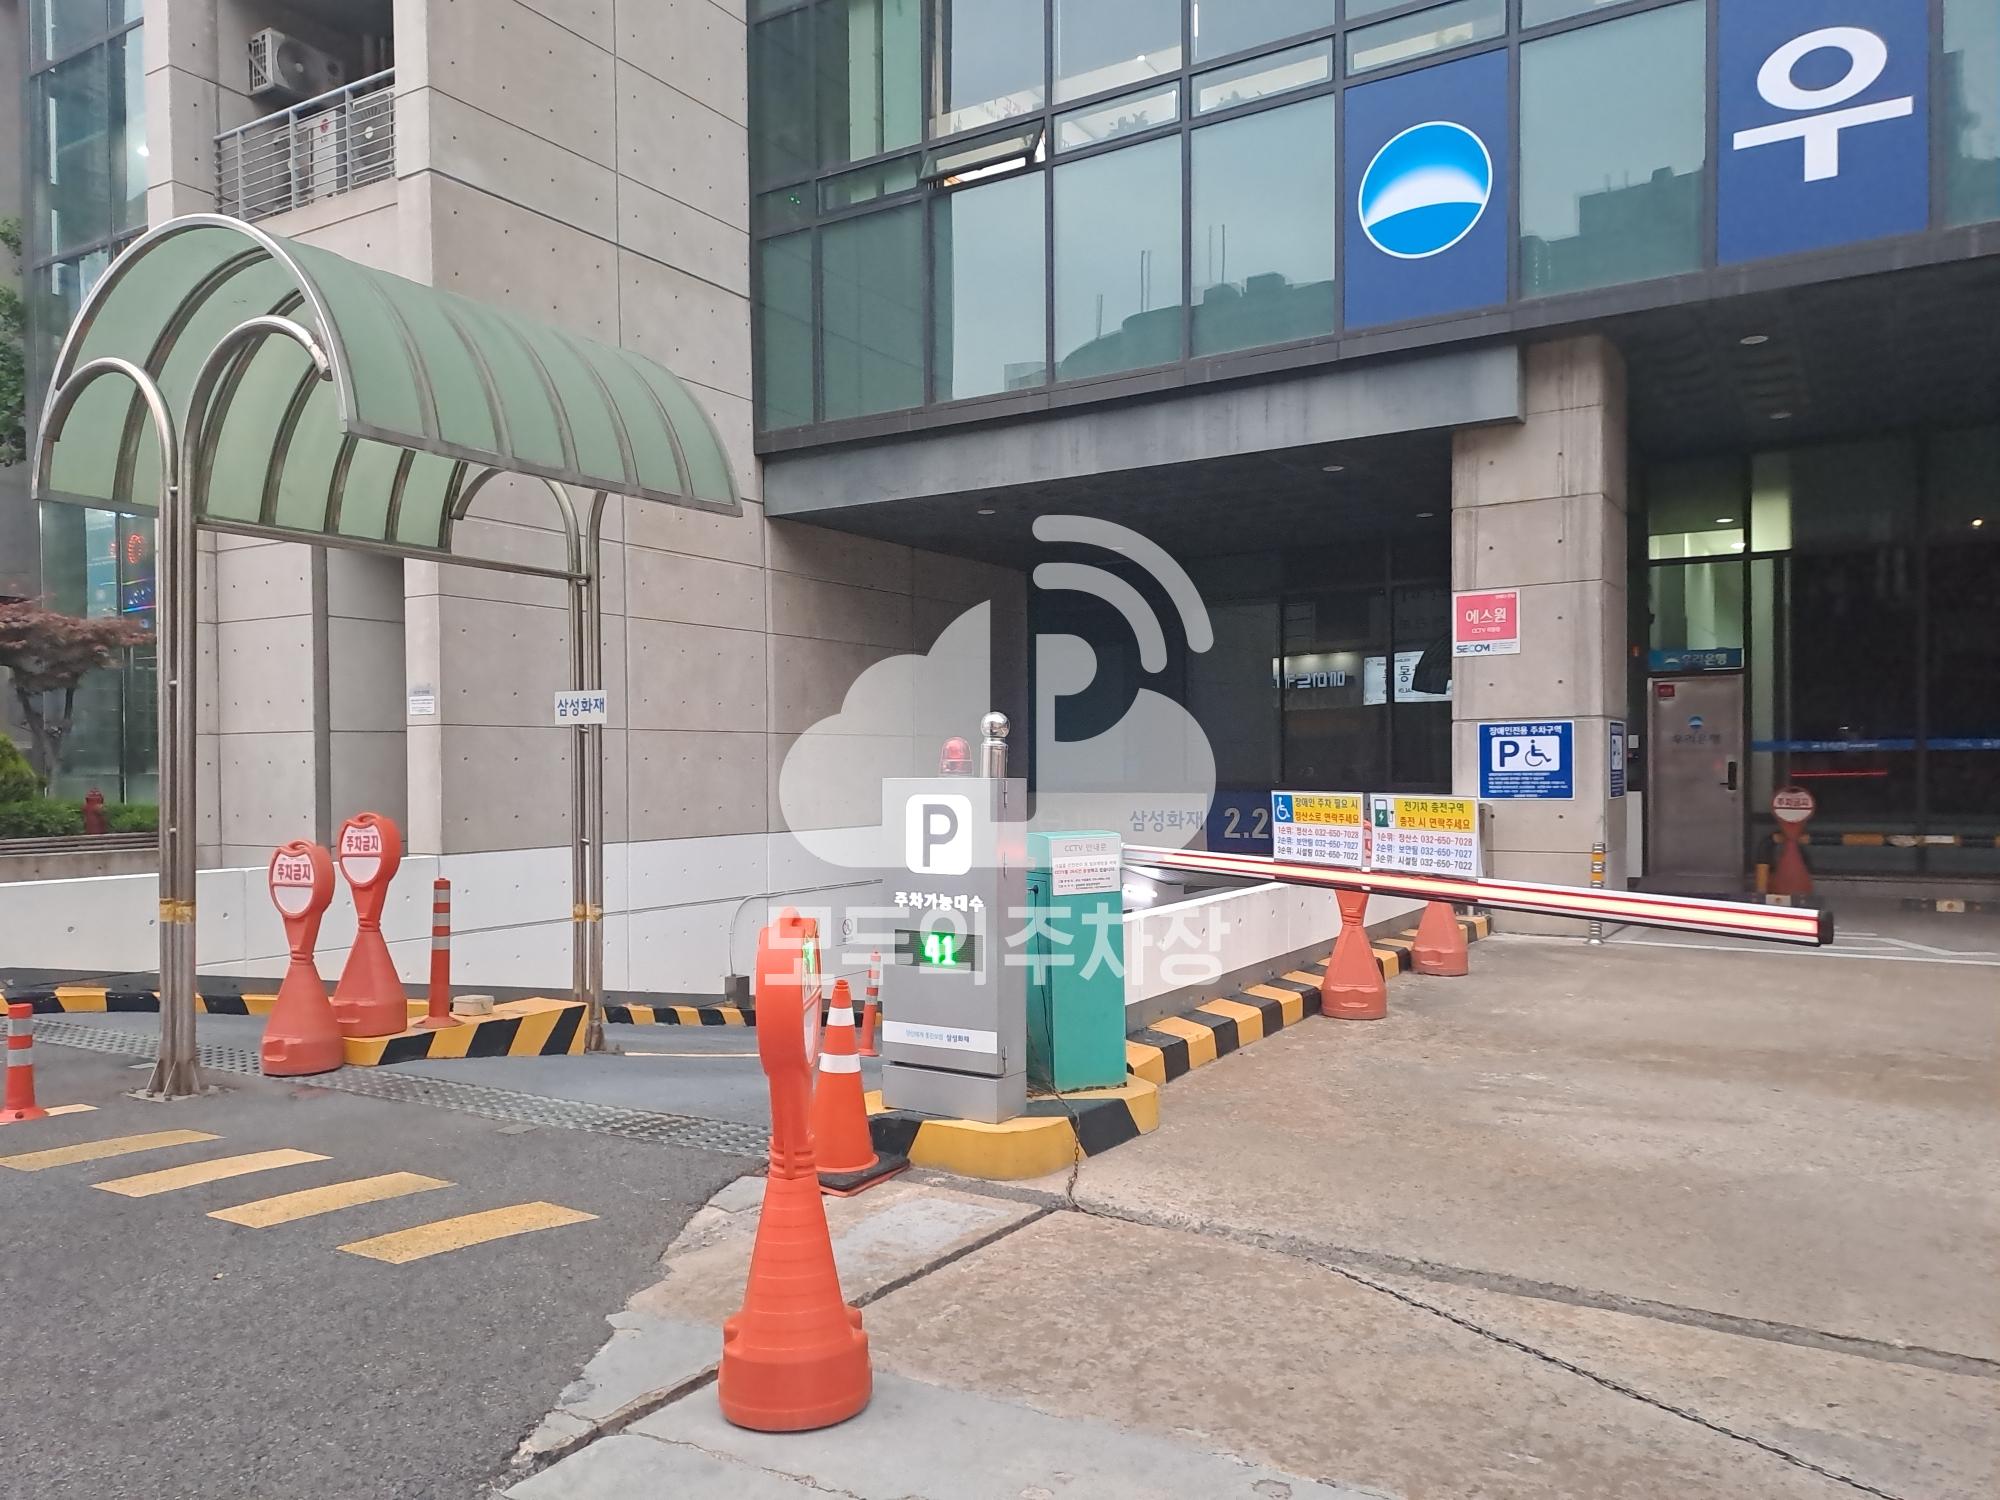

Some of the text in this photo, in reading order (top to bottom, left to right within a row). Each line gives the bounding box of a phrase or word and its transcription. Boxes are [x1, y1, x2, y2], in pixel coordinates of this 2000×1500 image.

[1733, 27, 1913, 182] 우
[1466, 608, 1506, 624] 에스원
[1456, 644, 1490, 654] SECOM
[557, 697, 604, 717] 삼성화재
[1488, 725, 1562, 736] 장애인전용 주차구역
[1500, 740, 1520, 768] P
[1295, 798, 1358, 810] 장애인 주차 필요 시
[1404, 801, 1464, 814] 전기차 충전구역
[1130, 809, 1203, 832] 삼성화재
[1224, 808, 1269, 838] 2.2
[1295, 812, 1359, 824] 정산소로 연락주세요
[1400, 816, 1470, 830] 충전 시 연락주세요
[922, 804, 958, 868] P
[1296, 827, 1313, 836] 정산소
[1314, 828, 1358, 838] 032-650-7028
[1377, 832, 1472, 846] 1순위: 정산소 032-650-7028
[346, 835, 379, 852] 주차금지
[1064, 844, 1082, 852] CCTV
[1314, 839, 1358, 850] 032-650-7027
[1376, 844, 1472, 858] 2순위: 보안팀 032-650-7027
[1296, 848, 1314, 857] 시설팀
[1314, 850, 1358, 860] 032-650-7022
[1376, 854, 1472, 870] 3순위: 시설팀 032-650-7022
[278, 864, 310, 880] 주차금지
[894, 891, 984, 912] 주차가능대수
[924, 934, 956, 966] 41
